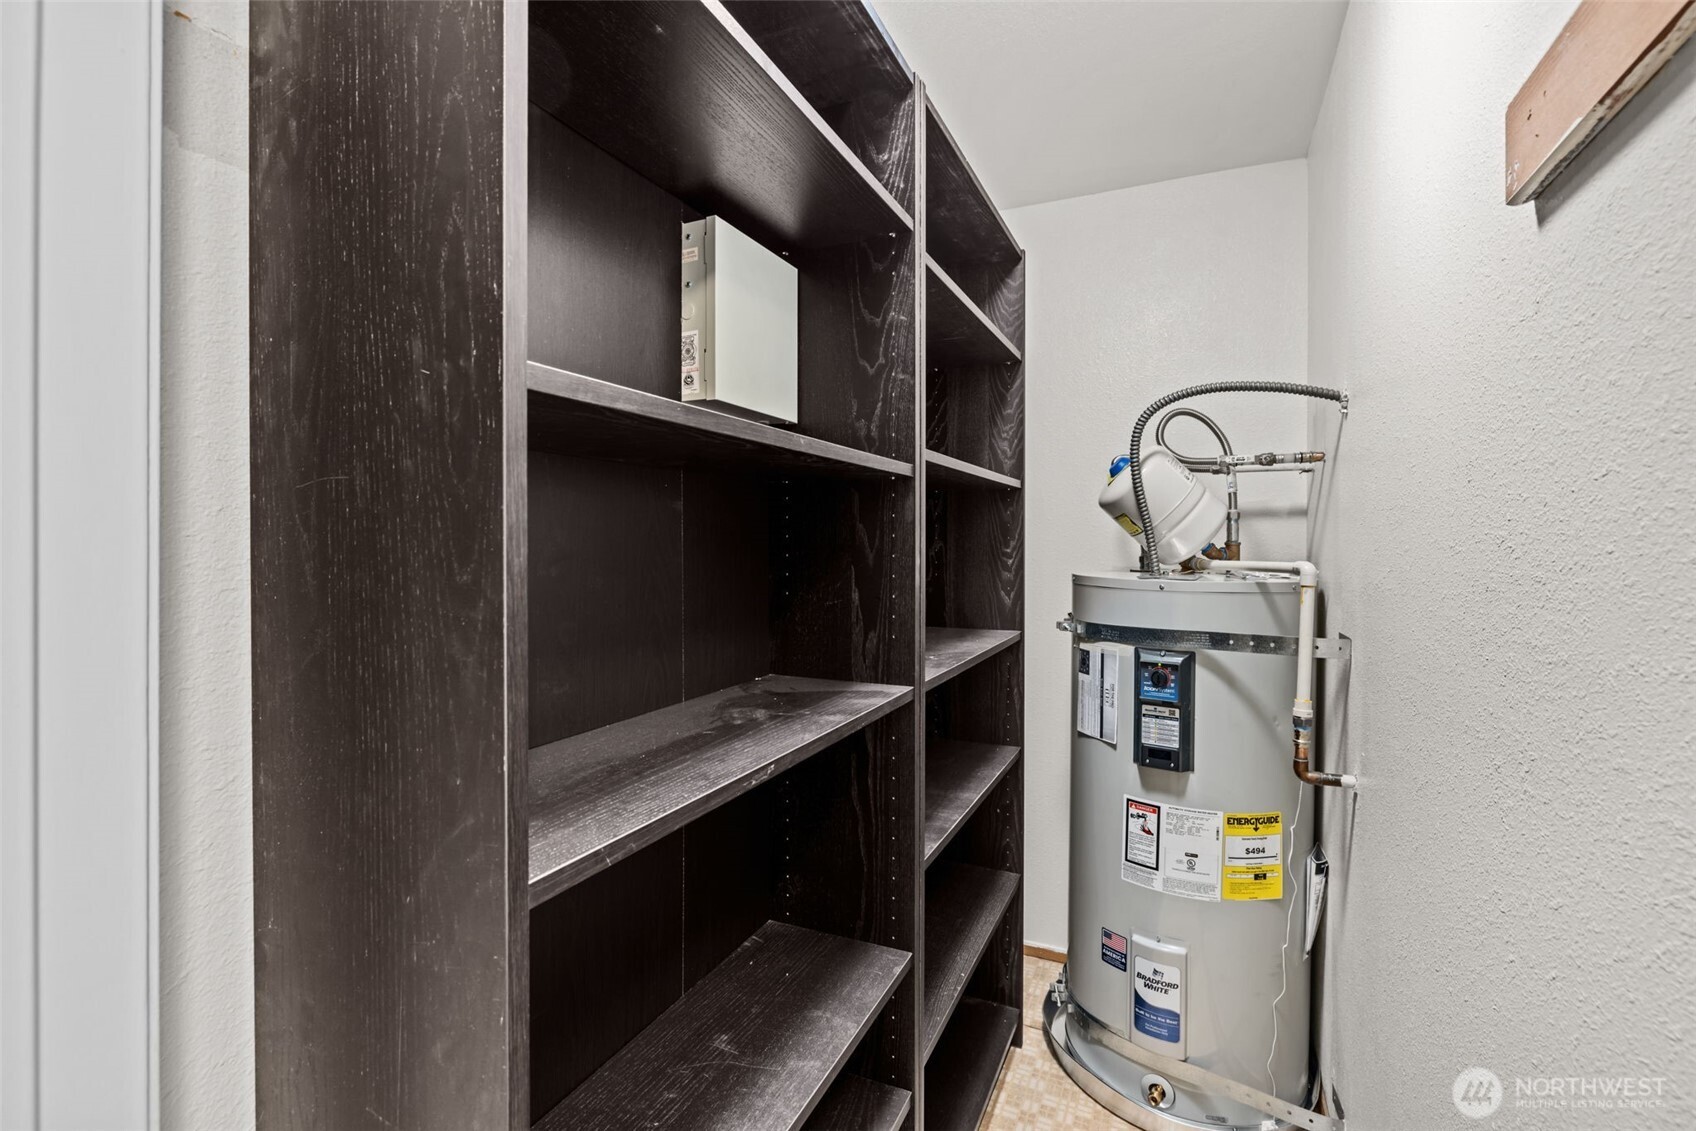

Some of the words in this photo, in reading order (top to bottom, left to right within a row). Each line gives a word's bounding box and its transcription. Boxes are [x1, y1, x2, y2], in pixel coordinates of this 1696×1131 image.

[1245, 847, 1266, 855] $494
[1103, 948, 1126, 963] AMERICA
[1136, 971, 1179, 989] BRADFORD
[1144, 981, 1169, 995] WHITE
